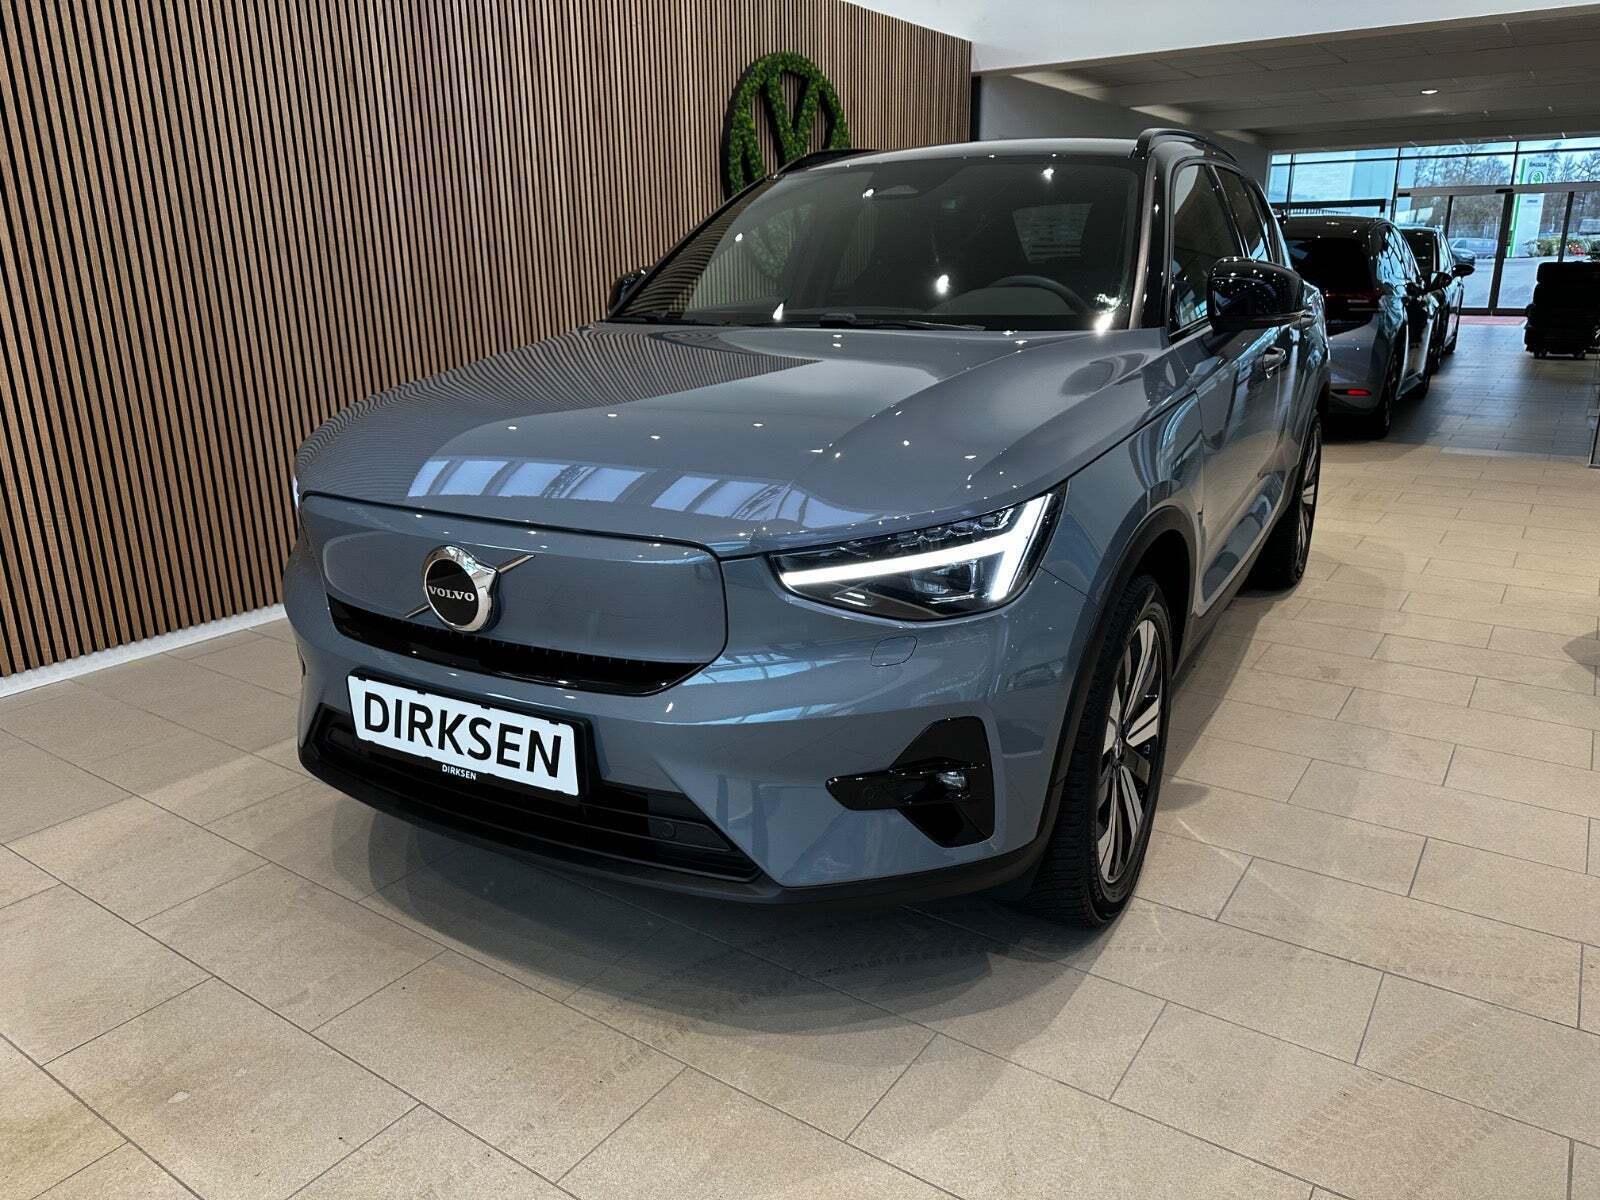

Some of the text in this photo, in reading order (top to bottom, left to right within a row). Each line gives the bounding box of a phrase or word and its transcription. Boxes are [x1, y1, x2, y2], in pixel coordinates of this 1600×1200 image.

[428, 585, 475, 602] VOLVO
[364, 691, 562, 778] DIRKSEN
[441, 763, 477, 781] DIRKSEN
